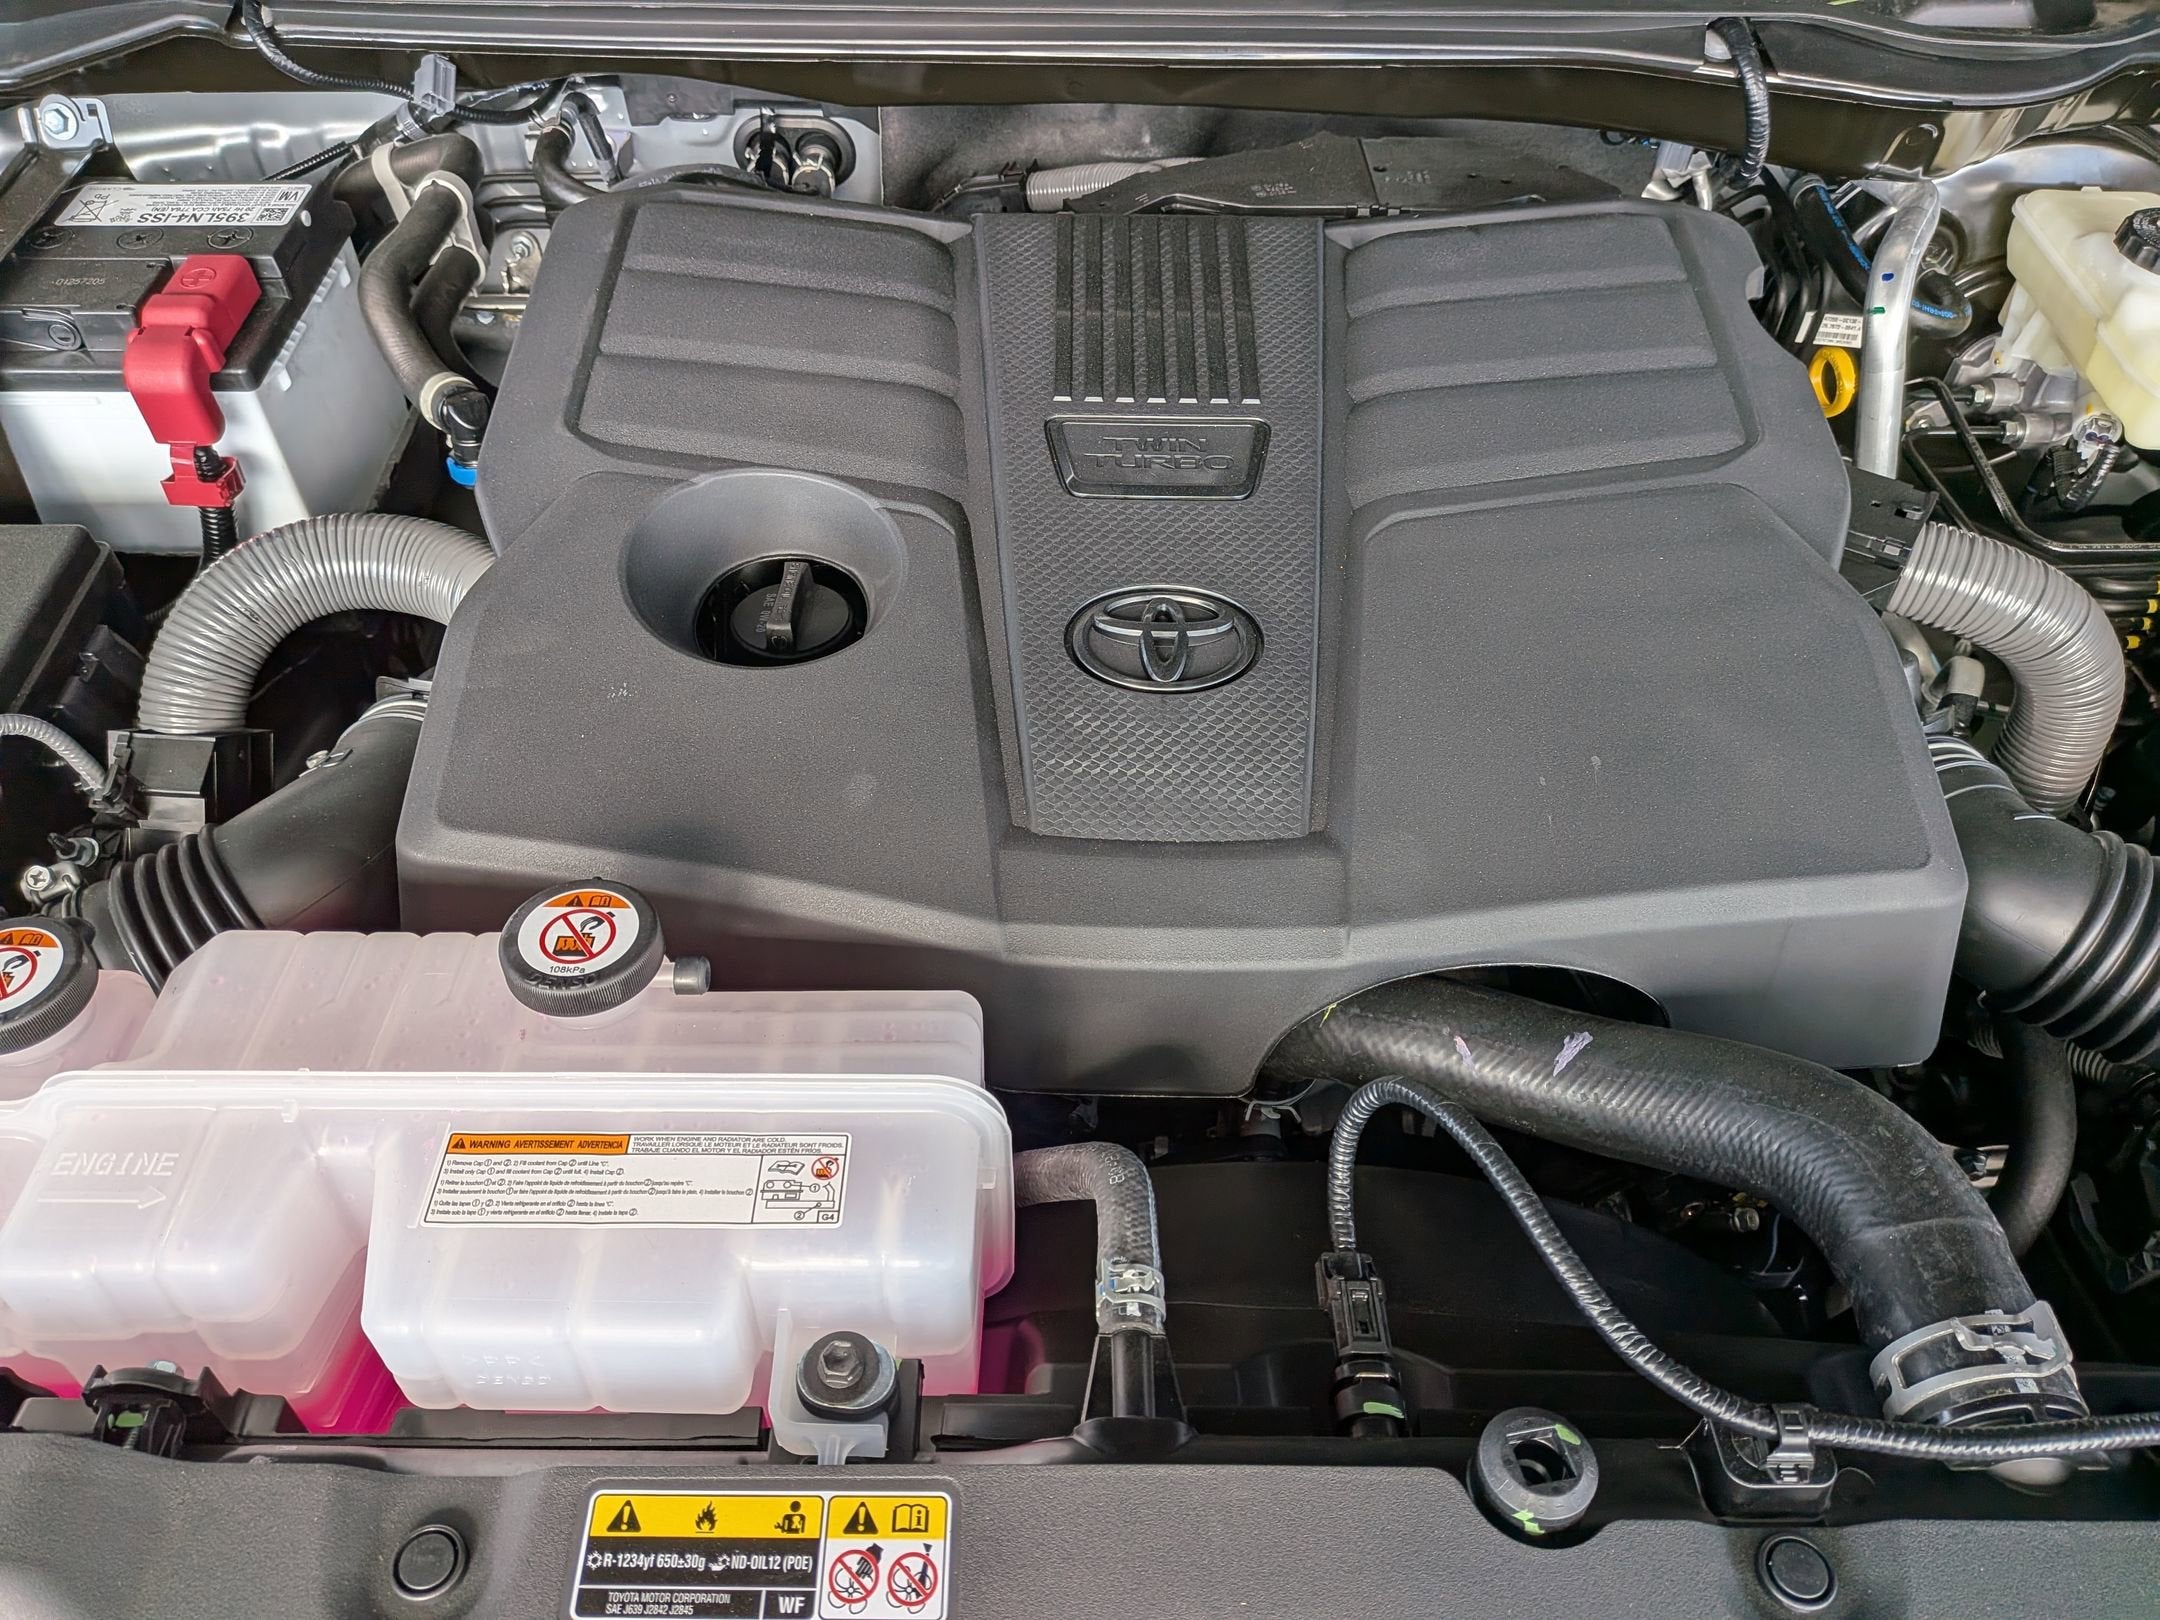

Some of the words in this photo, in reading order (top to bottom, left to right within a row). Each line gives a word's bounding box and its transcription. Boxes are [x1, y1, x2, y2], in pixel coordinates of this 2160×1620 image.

[278, 191, 299, 201] VM
[136, 213, 251, 223] 395LN4-ISS
[1102, 437, 1207, 452] TWIN
[1083, 453, 1236, 470] TURBO
[549, 966, 586, 974] 108kPa
[469, 1139, 511, 1149] WARNING
[513, 1140, 575, 1149] AVERTISSEMENT
[576, 1140, 623, 1150] ADVERTENCIA
[50, 1152, 180, 1176] ENGINE
[821, 1213, 835, 1221] G4
[603, 1553, 655, 1571] R-1234yf
[656, 1553, 706, 1572] 650±30g
[730, 1554, 781, 1571] ND-OIL12
[782, 1554, 813, 1573] (POE)
[608, 1591, 640, 1603] TOYOTA
[641, 1592, 671, 1603] MOTOR
[672, 1592, 731, 1604] CORPORATION
[605, 1604, 622, 1615] SAE
[622, 1604, 643, 1615] J639
[643, 1604, 668, 1616] J2842
[669, 1604, 694, 1616] J2845
[777, 1595, 807, 1614] WF
